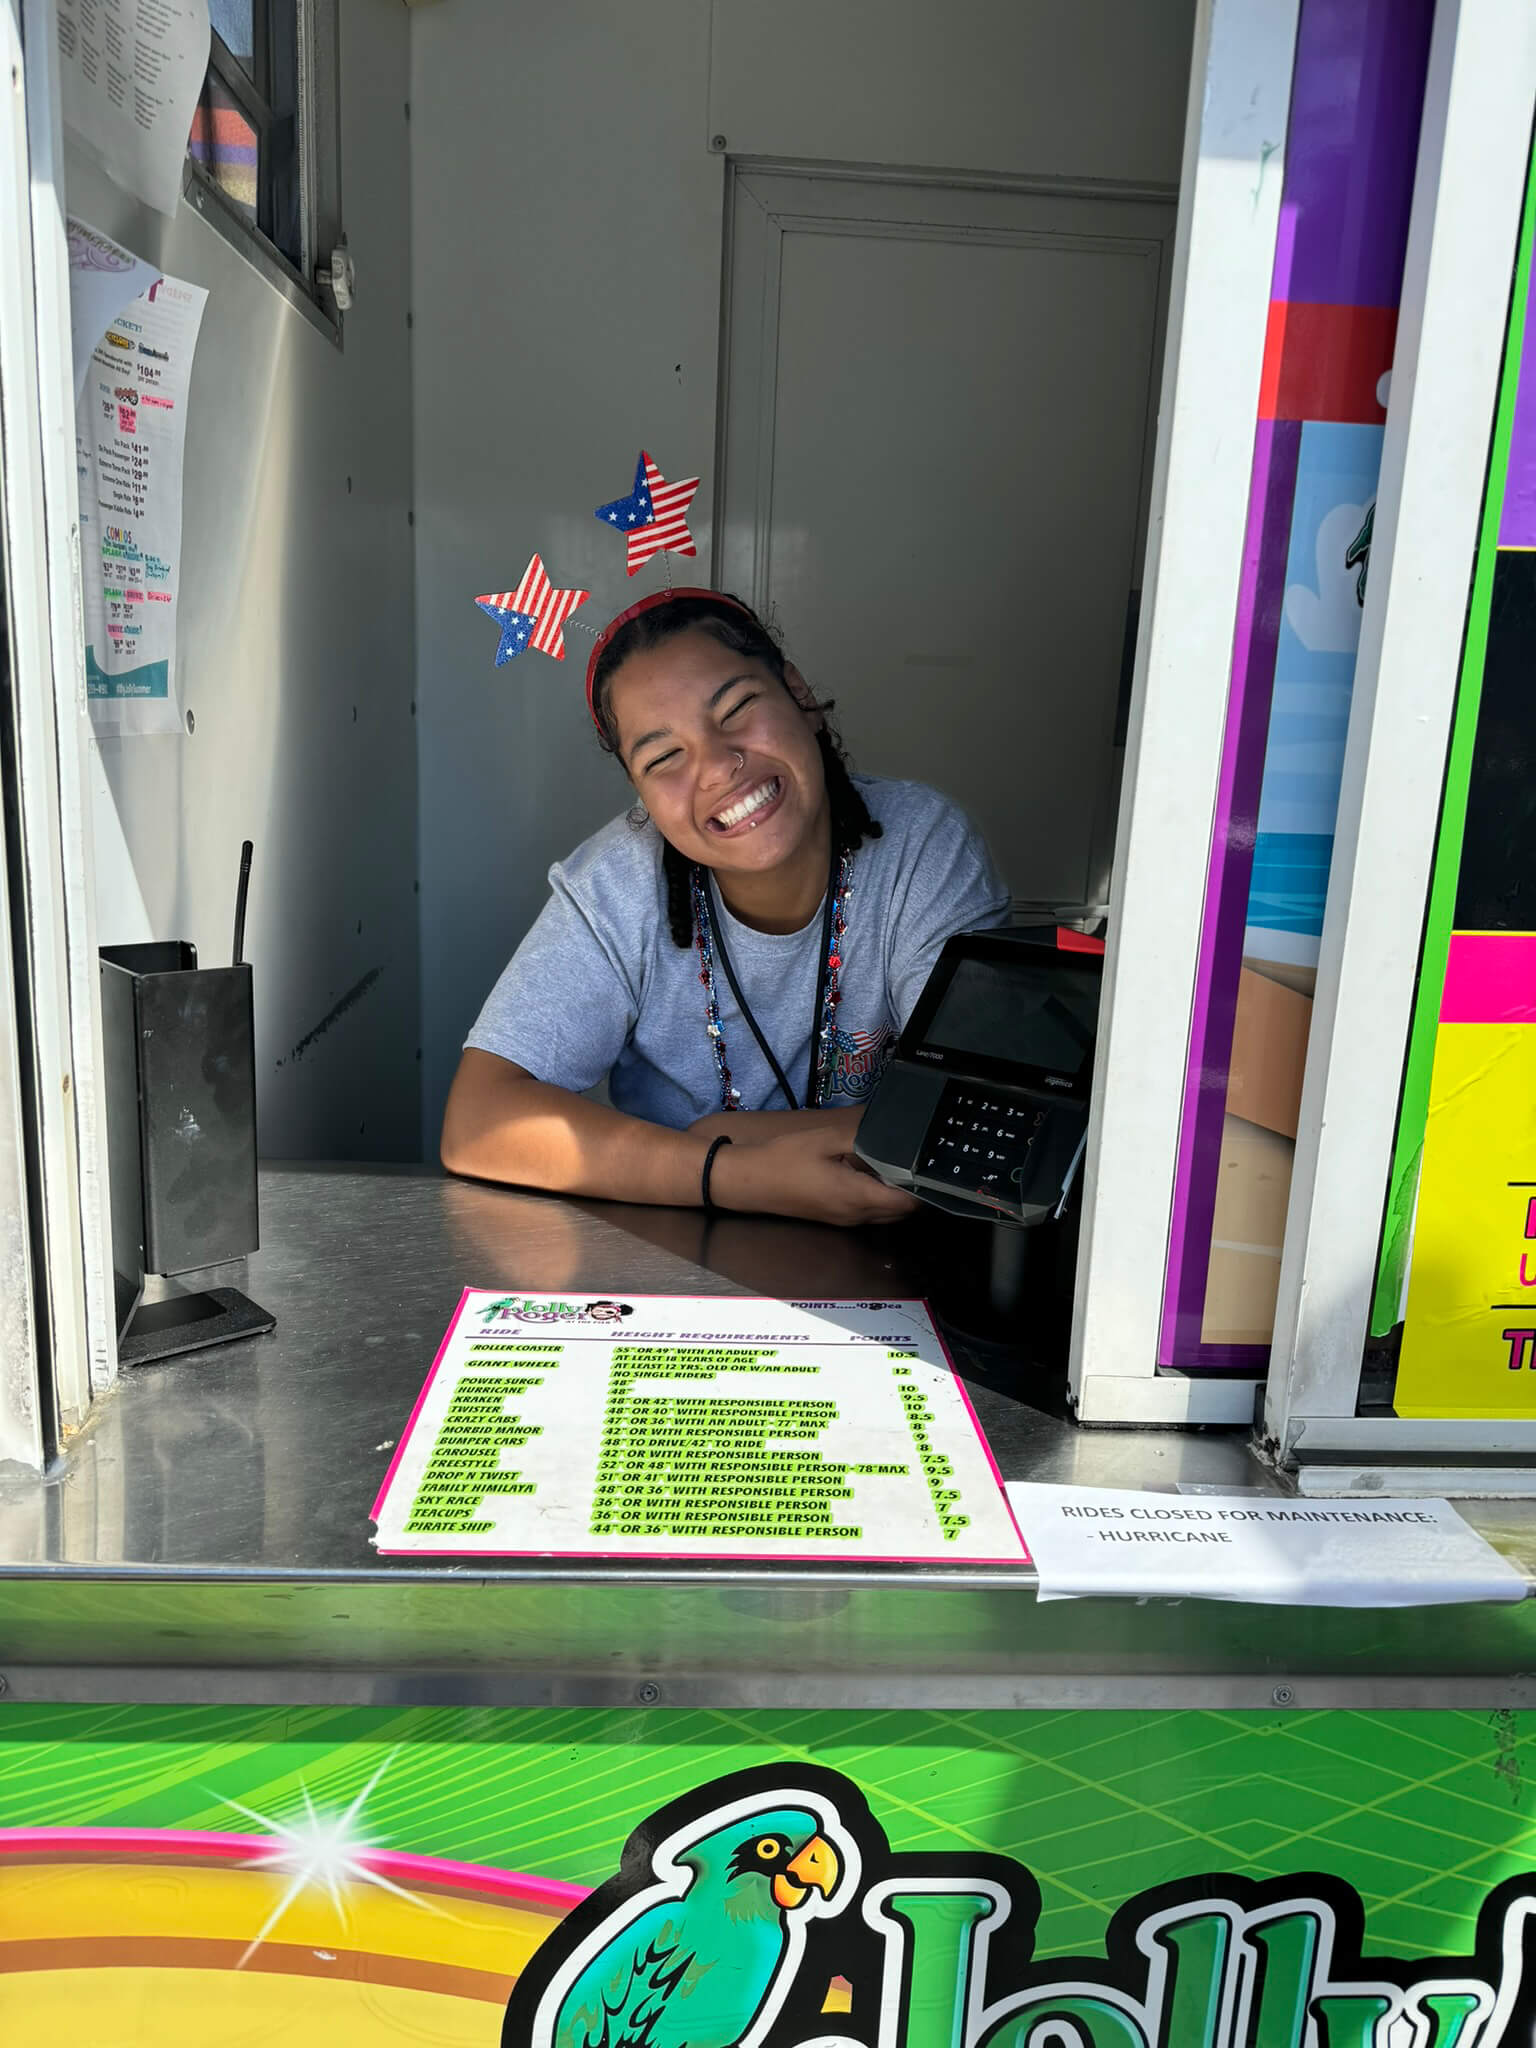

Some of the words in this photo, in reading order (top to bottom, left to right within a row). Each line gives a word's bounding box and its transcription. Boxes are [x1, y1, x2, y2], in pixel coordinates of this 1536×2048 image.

[513, 1300, 583, 1313] Jolly
[500, 1308, 589, 1324] Roger
[680, 1333, 810, 1341] REQUIREMENTS
[710, 1399, 785, 1407] RESPONSIBLE
[711, 1409, 787, 1417] RESPONSIBLE
[791, 1410, 837, 1418] PERSON
[674, 1418, 705, 1426] WITH
[728, 1419, 765, 1427] ADULT
[800, 1420, 827, 1428] MAX
[686, 1429, 765, 1437] RESPONSIBLE
[769, 1430, 815, 1438] PERSON
[649, 1439, 712, 1447] DRIVE/42"
[735, 1440, 763, 1448] RIDE
[771, 1452, 819, 1460] PERSON
[648, 1462, 670, 1470] 48"
[710, 1463, 791, 1472] RESPONSIBLE
[859, 1465, 906, 1473] 78"MAX
[427, 1472, 463, 1480] DROP
[467, 1472, 476, 1480] N
[480, 1472, 519, 1480] TWIST
[644, 1474, 663, 1482] 41"
[704, 1475, 788, 1483] RESPONSIBLE
[792, 1476, 842, 1484] PERSON
[422, 1484, 469, 1492] FAMILY
[472, 1484, 533, 1492] HIMILAYA
[599, 1486, 622, 1494] 48"
[624, 1486, 643, 1494] OR
[648, 1487, 670, 1495] 36"
[673, 1487, 706, 1495] WITH
[711, 1487, 796, 1496] RESPONSIBLE
[801, 1488, 851, 1497] PERSON
[934, 1491, 957, 1499] 7.5
[622, 1499, 641, 1507] OR
[646, 1499, 680, 1507] WITH
[685, 1500, 771, 1509] RESPONSIBLE
[776, 1501, 827, 1509] PERSON
[414, 1509, 472, 1517] TEACUPS
[942, 1517, 967, 1525] 7.5
[1061, 1506, 1123, 1520] RIDES
[1130, 1508, 1213, 1521] CLOSED
[1219, 1510, 1264, 1522] FOR
[1266, 1510, 1437, 1524] MAINTENANCE:
[408, 1522, 456, 1531] PIRATE
[459, 1522, 492, 1531] SHIP
[593, 1525, 618, 1533] 44"
[621, 1525, 641, 1533] OR
[644, 1525, 668, 1533] 36"
[672, 1526, 707, 1534] WITH
[712, 1526, 800, 1535] RESPONSIBLE
[806, 1528, 858, 1536] PERSON
[946, 1530, 955, 1538] 7
[1099, 1530, 1233, 1543] HURRICANE
